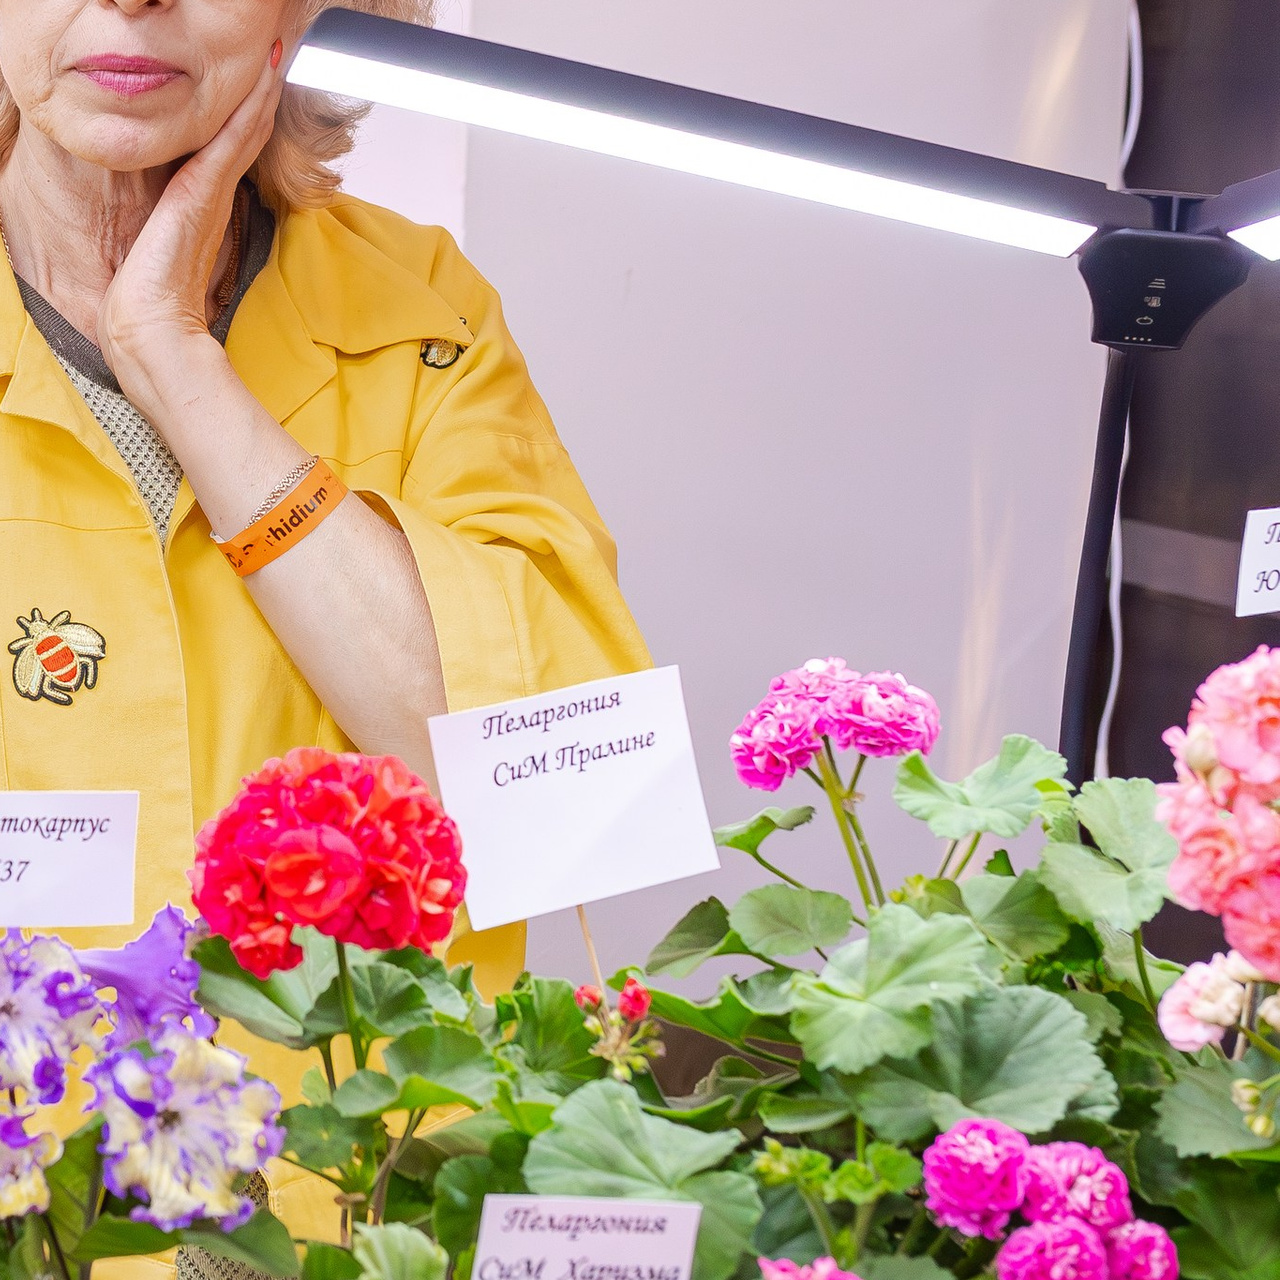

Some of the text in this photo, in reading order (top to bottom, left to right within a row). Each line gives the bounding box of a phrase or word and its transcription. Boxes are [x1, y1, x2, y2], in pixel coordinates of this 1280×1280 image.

[481, 691, 622, 740] Пеларгония
[493, 731, 656, 788] СиМ Пралине
[501, 1206, 669, 1242] Пеларгония
